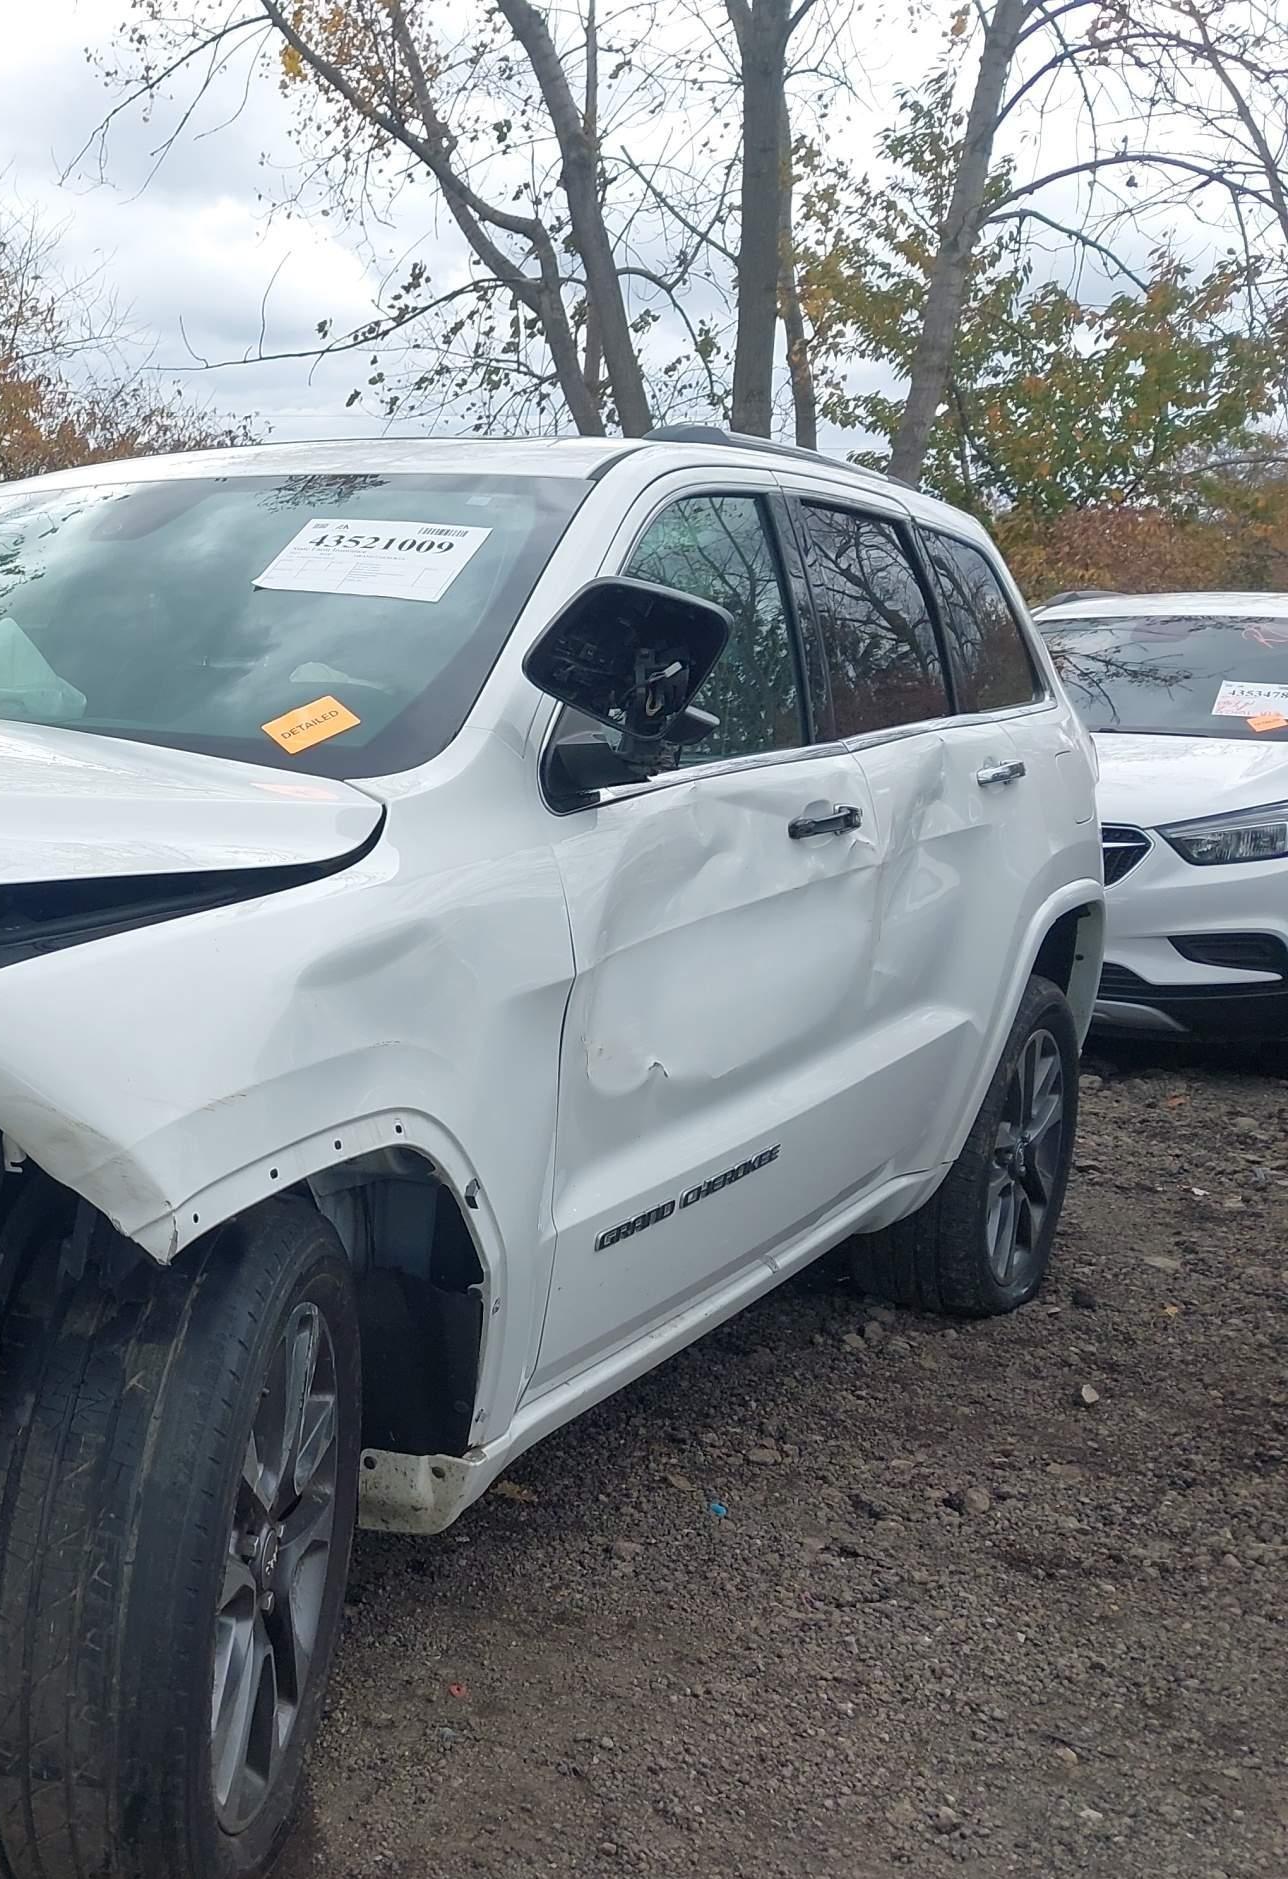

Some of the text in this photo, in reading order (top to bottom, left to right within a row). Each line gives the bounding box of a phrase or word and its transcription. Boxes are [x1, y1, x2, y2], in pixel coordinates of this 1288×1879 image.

[309, 534, 454, 554] 43521009
[281, 710, 339, 739] DETAILED
[594, 1143, 782, 1252] GRAND CHEROKEE
